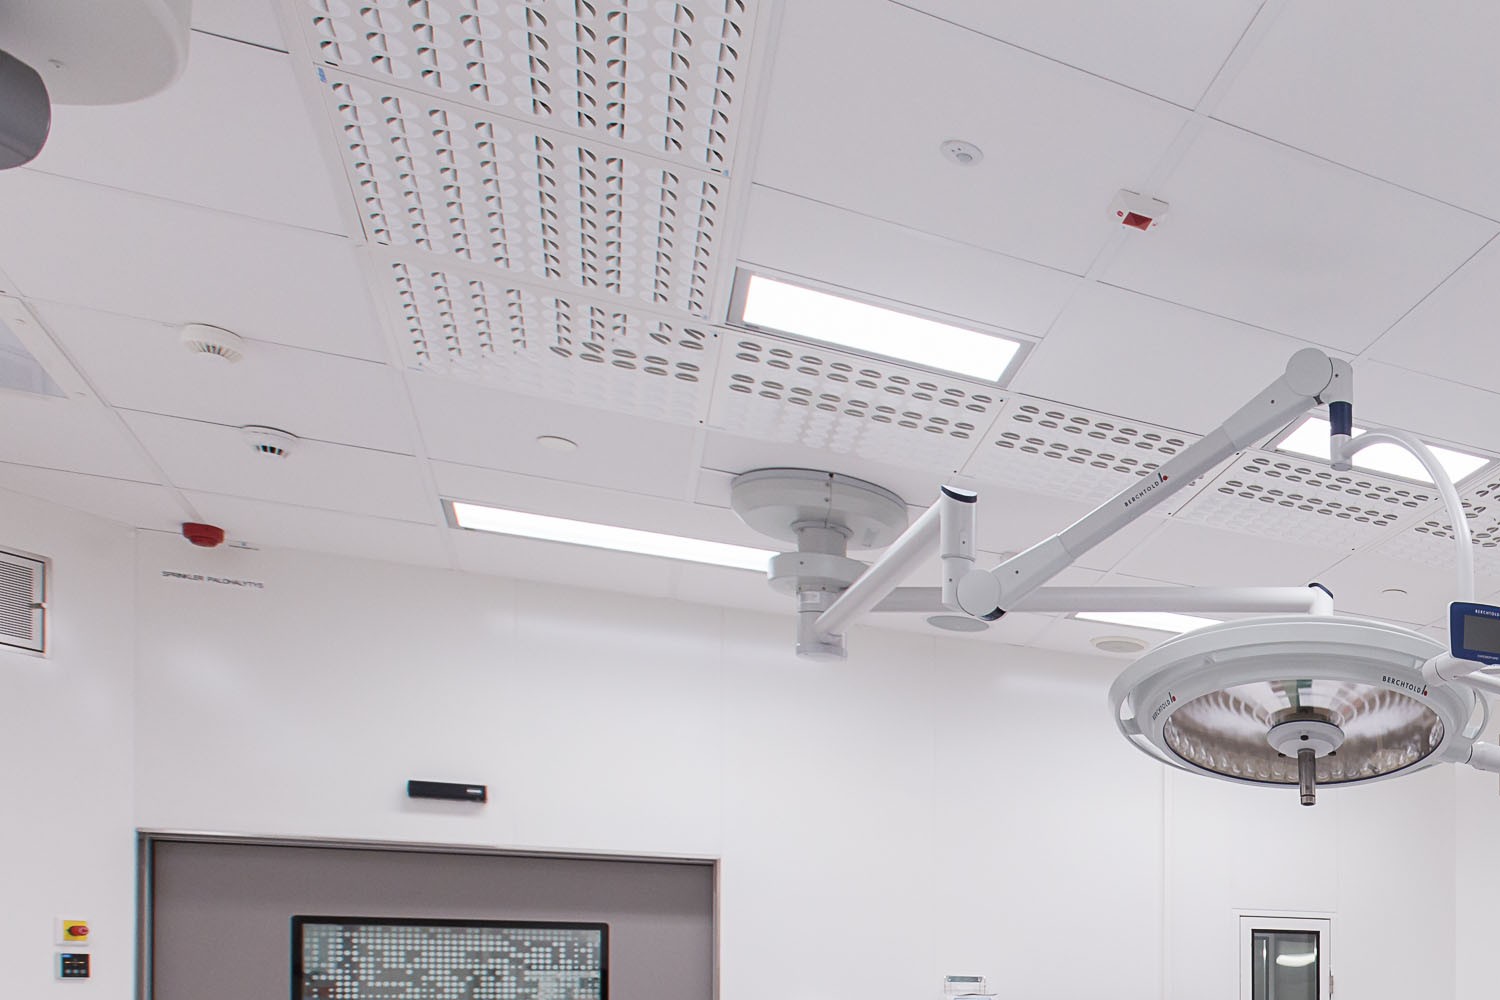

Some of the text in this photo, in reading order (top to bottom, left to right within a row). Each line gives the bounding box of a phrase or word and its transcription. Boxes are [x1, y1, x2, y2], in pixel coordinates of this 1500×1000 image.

[1124, 481, 1159, 507] BERCHTOLD
[162, 571, 204, 581] SPRINKLER
[1475, 609, 1500, 617] BERCHTOLD
[1382, 675, 1421, 694] BERCHTOLD
